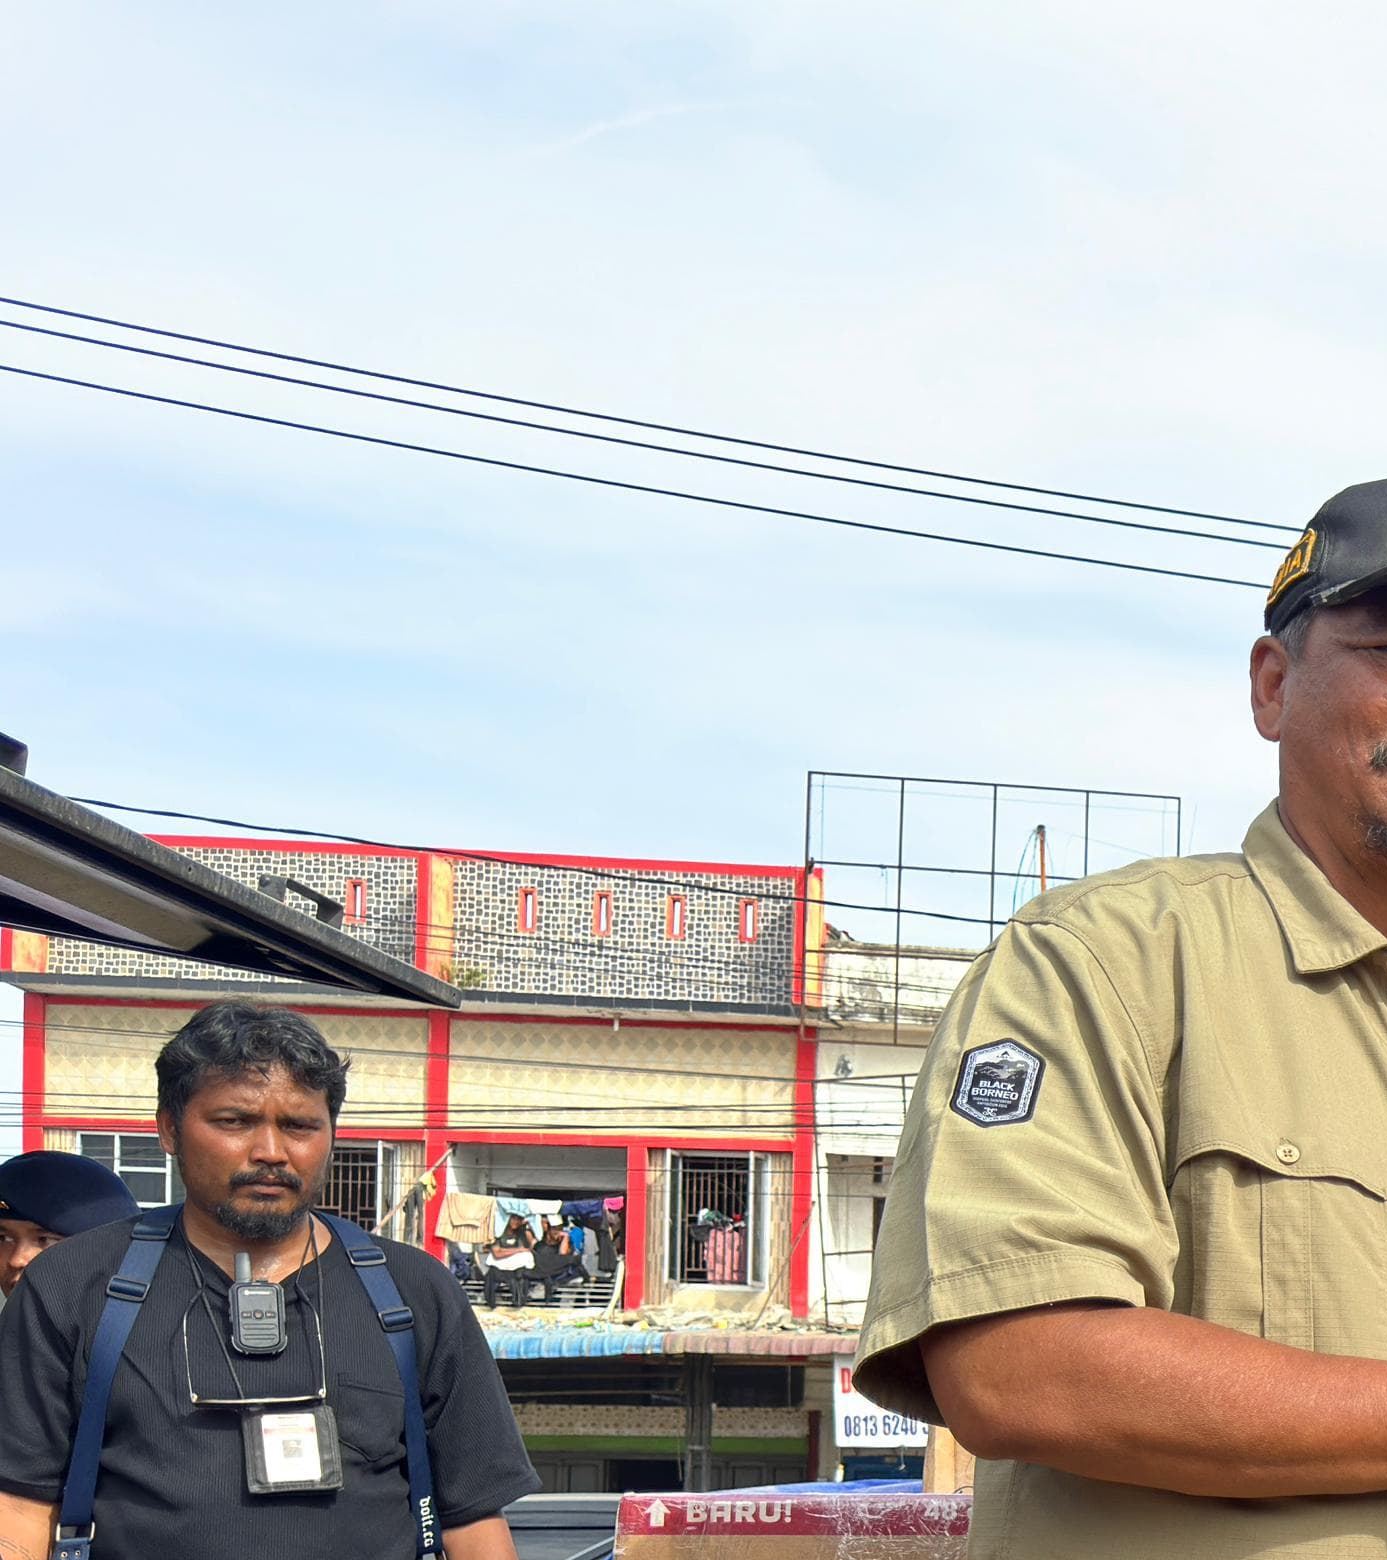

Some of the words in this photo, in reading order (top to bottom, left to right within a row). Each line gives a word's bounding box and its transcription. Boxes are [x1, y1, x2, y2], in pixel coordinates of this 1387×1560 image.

[971, 1087, 1019, 1101] BORNEO
[979, 1080, 1015, 1091] BLACK
[844, 1415, 878, 1437] 0813
[686, 1500, 792, 1524] BARU!
